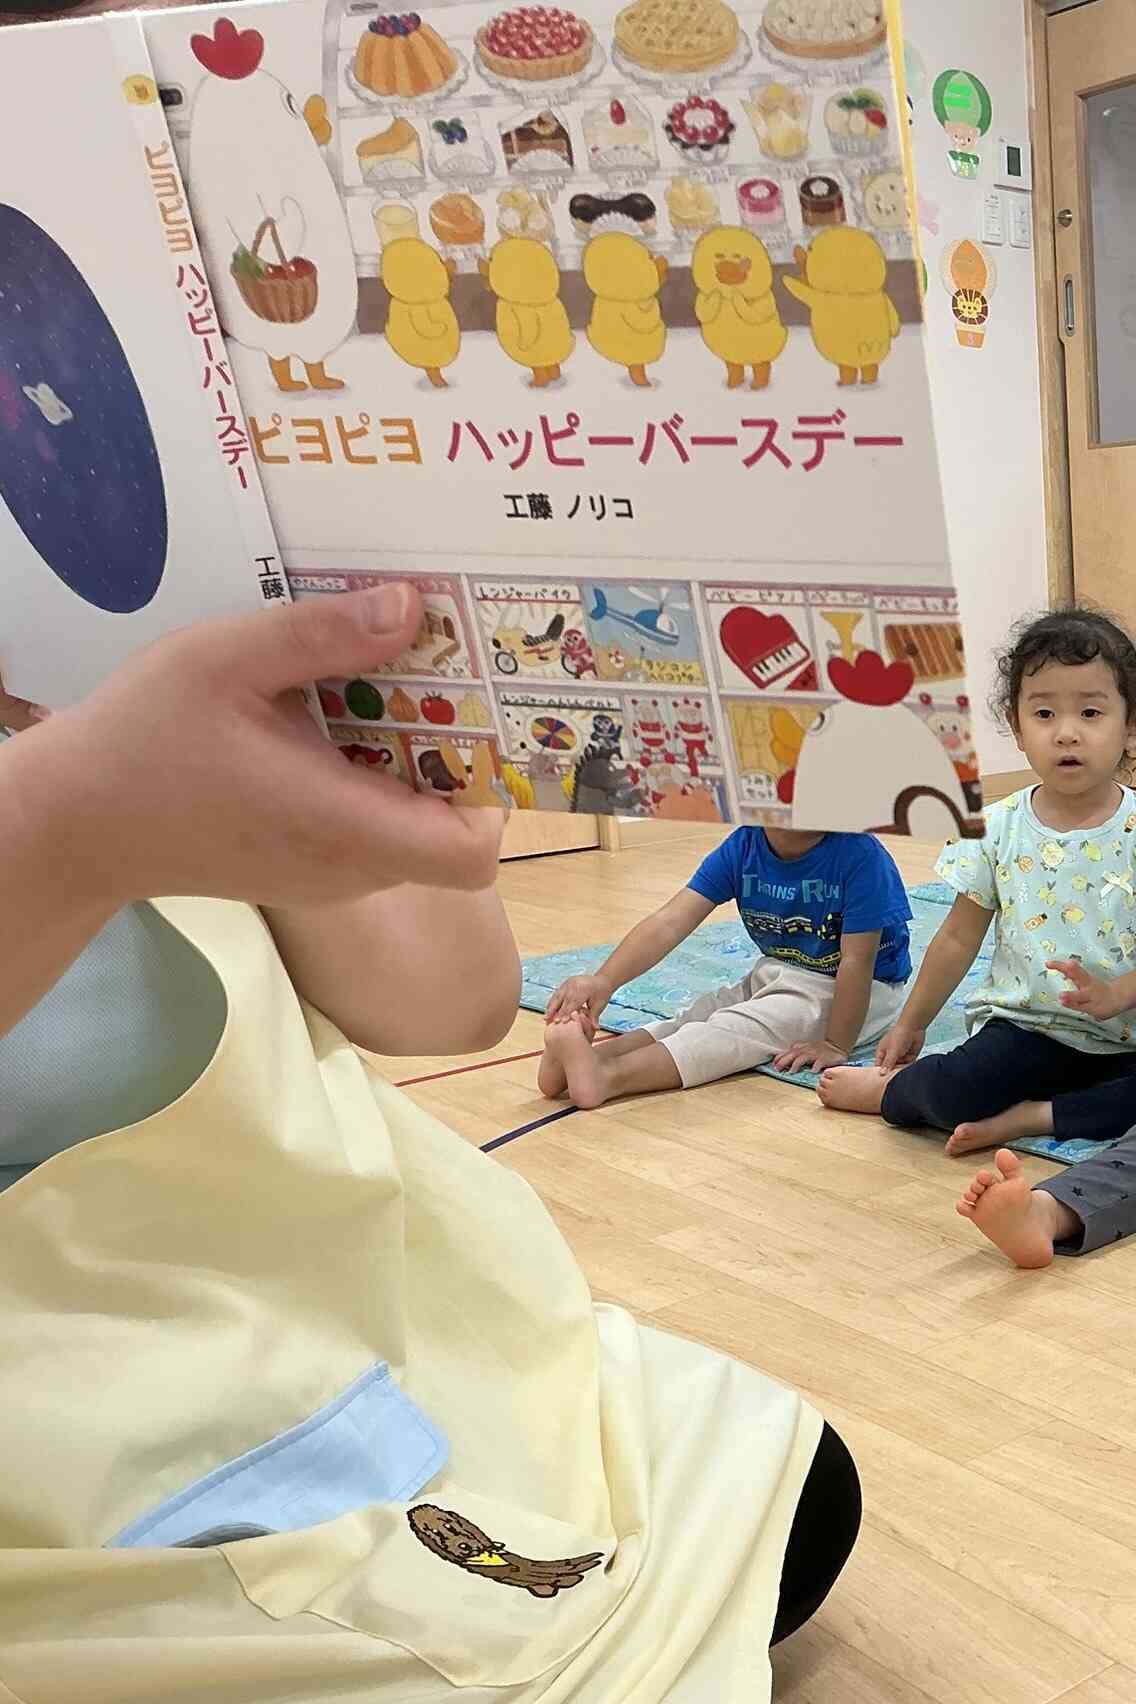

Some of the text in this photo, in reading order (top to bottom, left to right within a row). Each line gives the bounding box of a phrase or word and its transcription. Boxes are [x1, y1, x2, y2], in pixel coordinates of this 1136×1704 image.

[144, 141, 249, 489] ピヨピヨ ハッピーバースデー
[249, 408, 904, 472] ピヨピヨ ハッピーバースデー
[503, 493, 634, 521] 工藤 ノリコ
[254, 555, 285, 601] 工藤
